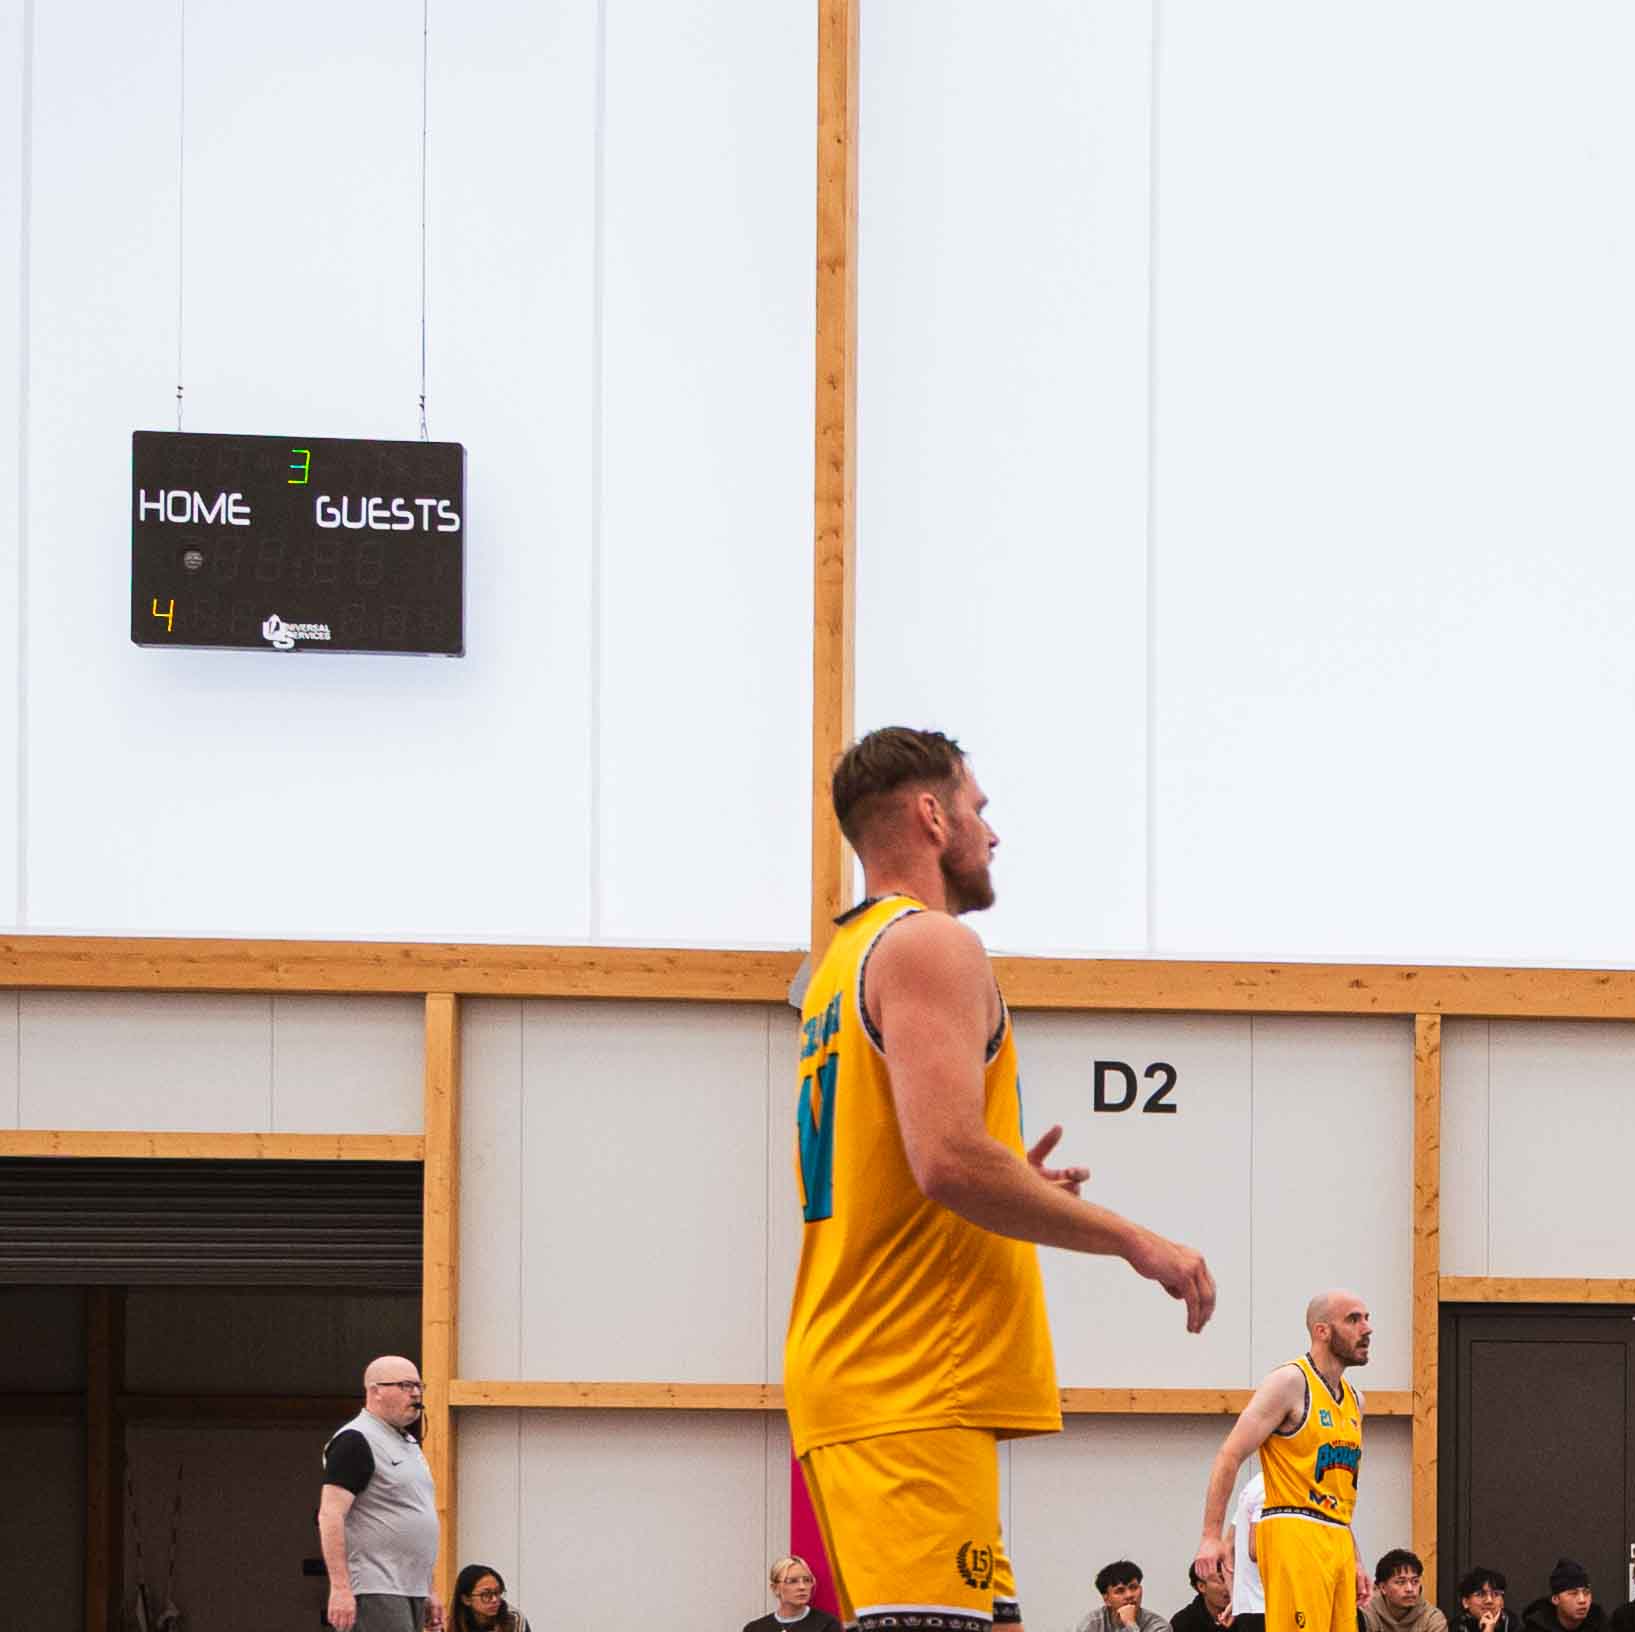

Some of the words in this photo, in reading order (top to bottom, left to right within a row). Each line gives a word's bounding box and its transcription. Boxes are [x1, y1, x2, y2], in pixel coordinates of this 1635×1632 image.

[287, 448, 312, 485] 3
[138, 489, 252, 527] HOME
[315, 495, 461, 533] GUESTS
[151, 597, 175, 633] 4
[1093, 1060, 1179, 1115] D2
